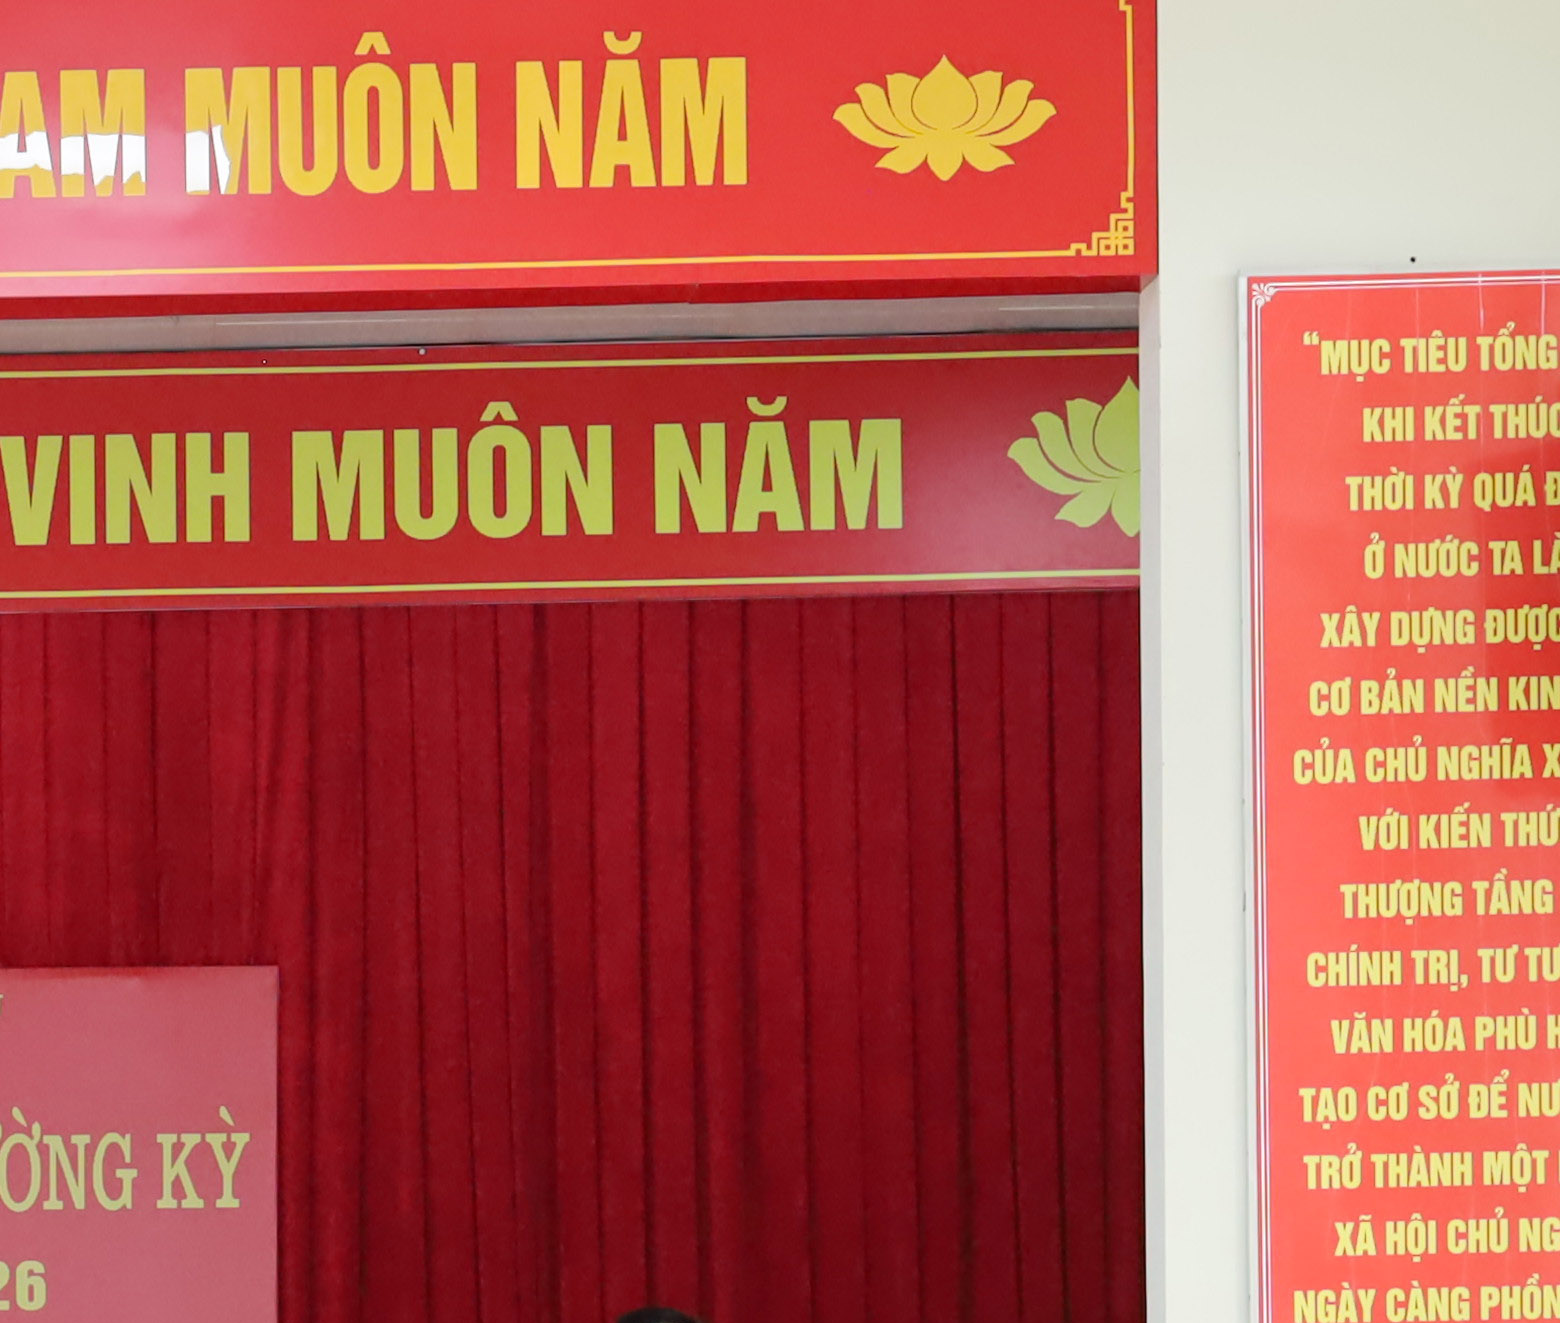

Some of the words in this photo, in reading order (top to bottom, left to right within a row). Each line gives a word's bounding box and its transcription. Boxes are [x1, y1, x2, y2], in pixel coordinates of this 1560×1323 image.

[186, 32, 478, 195] MUÔN
[517, 32, 748, 188] NĂM
[1398, 330, 1469, 373] TIÊU
[1474, 322, 1560, 371] TỔNG
[1362, 406, 1416, 442] KHI
[1424, 395, 1483, 440] KẾT
[0, 432, 251, 545] VINH
[286, 402, 618, 540] MUÔN
[650, 397, 909, 535] NĂM
[1292, 737, 1358, 784] CỦA
[1364, 736, 1429, 783] CHỦ
[1436, 738, 1534, 781] NGHĨA
[1338, 879, 1465, 924] THƯỢNG
[1472, 869, 1556, 915] TẦNG
[1306, 944, 1403, 987] CHÍNH
[1410, 950, 1470, 991] TRỊ,
[1476, 945, 1519, 983] TƯ
[157, 1106, 250, 1209] KỲ
[1292, 1282, 1377, 1323] NGÀY
[1384, 1281, 1472, 1322] CÀNG
